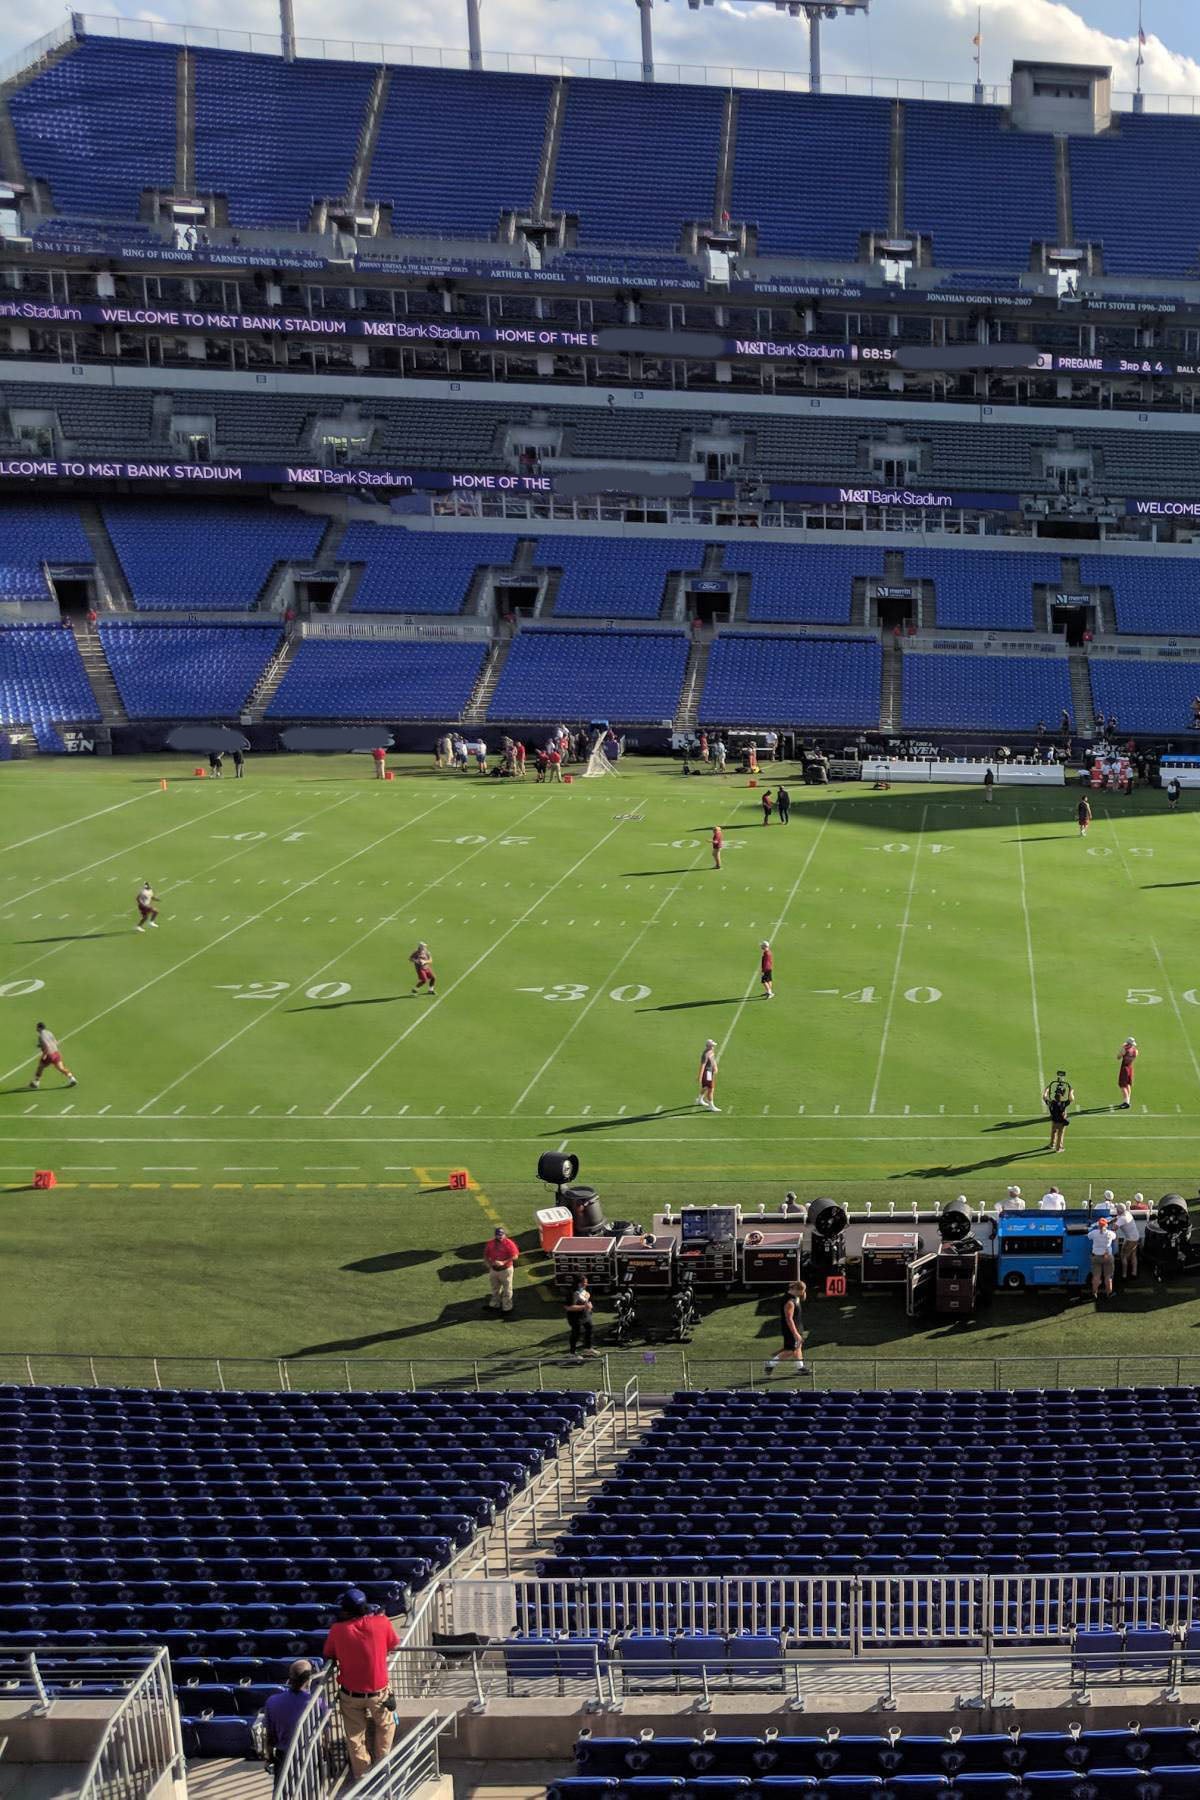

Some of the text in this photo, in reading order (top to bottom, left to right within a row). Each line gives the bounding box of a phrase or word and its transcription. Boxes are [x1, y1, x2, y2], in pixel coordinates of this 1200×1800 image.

[122, 248, 145, 258] RING
[147, 250, 159, 259] OF
[161, 251, 193, 261] HONOR
[210, 254, 324, 269] EARNEST BYNER 1996-2003
[491, 270, 522, 280] ARTHUR
[534, 272, 566, 282] MODELL
[586, 275, 700, 289] MICHAEL McCRARY 1997-2002
[754, 284, 861, 297] PETER BOULWARE 1997-2005
[926, 293, 1032, 306] JONATHAN OGDEN 1996-2007
[1088, 301, 1176, 313] MATT STOVER 1996-2008
[23, 303, 82, 321] Stadium
[101, 309, 346, 334] WELCOME TO M&T BANK STADIUM
[363, 321, 480, 341] M&T Bank Stadium
[495, 329, 535, 342] HOME
[539, 331, 561, 344] OF
[562, 332, 588, 345] THE
[736, 341, 844, 359] M&T Bank Stadium
[1058, 358, 1103, 369] PREGAME
[1120, 361, 1163, 372] 3RD & 4
[1177, 365, 1195, 374] BALL
[61, 463, 85, 476] TO
[89, 464, 123, 477] M&T
[128, 465, 170, 478] BANK
[175, 466, 242, 480] STADIUM
[287, 468, 413, 486] M&T Bank Stadium
[453, 475, 551, 490] HOME OF THE
[839, 489, 952, 507] M&T Bank Stadium
[451, 1173, 466, 1187] 30
[828, 1279, 845, 1294] 40
